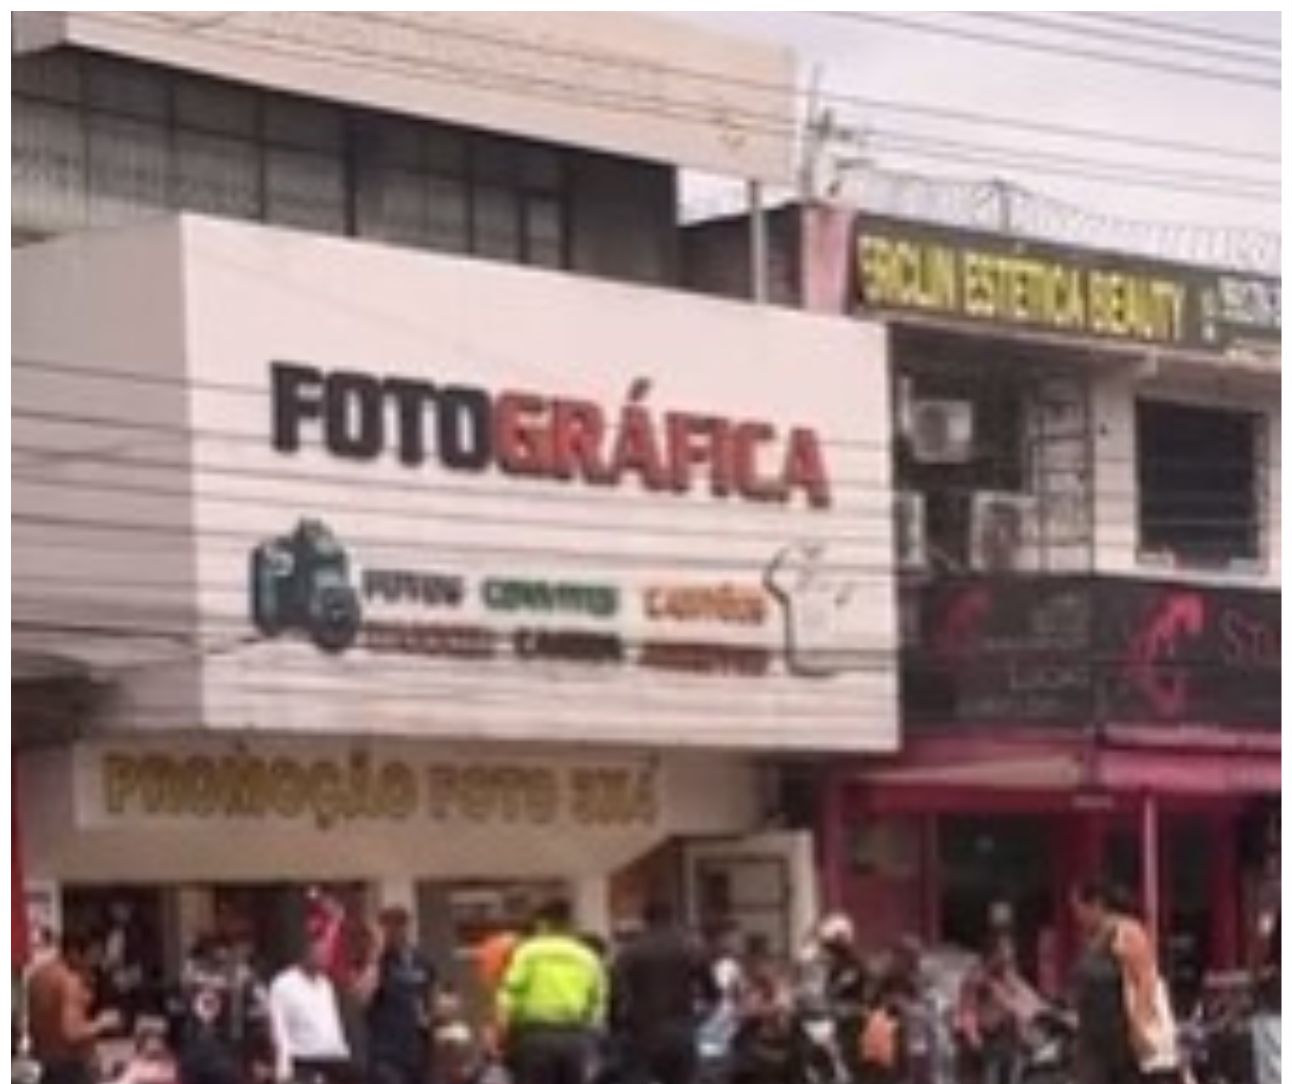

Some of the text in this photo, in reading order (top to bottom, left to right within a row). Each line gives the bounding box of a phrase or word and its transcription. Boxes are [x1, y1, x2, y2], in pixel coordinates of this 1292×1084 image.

[1087, 270, 1185, 342] BEAUTY
[269, 359, 832, 510] FOTOGRÁFICA
[102, 750, 420, 829] PROMOÇÃO
